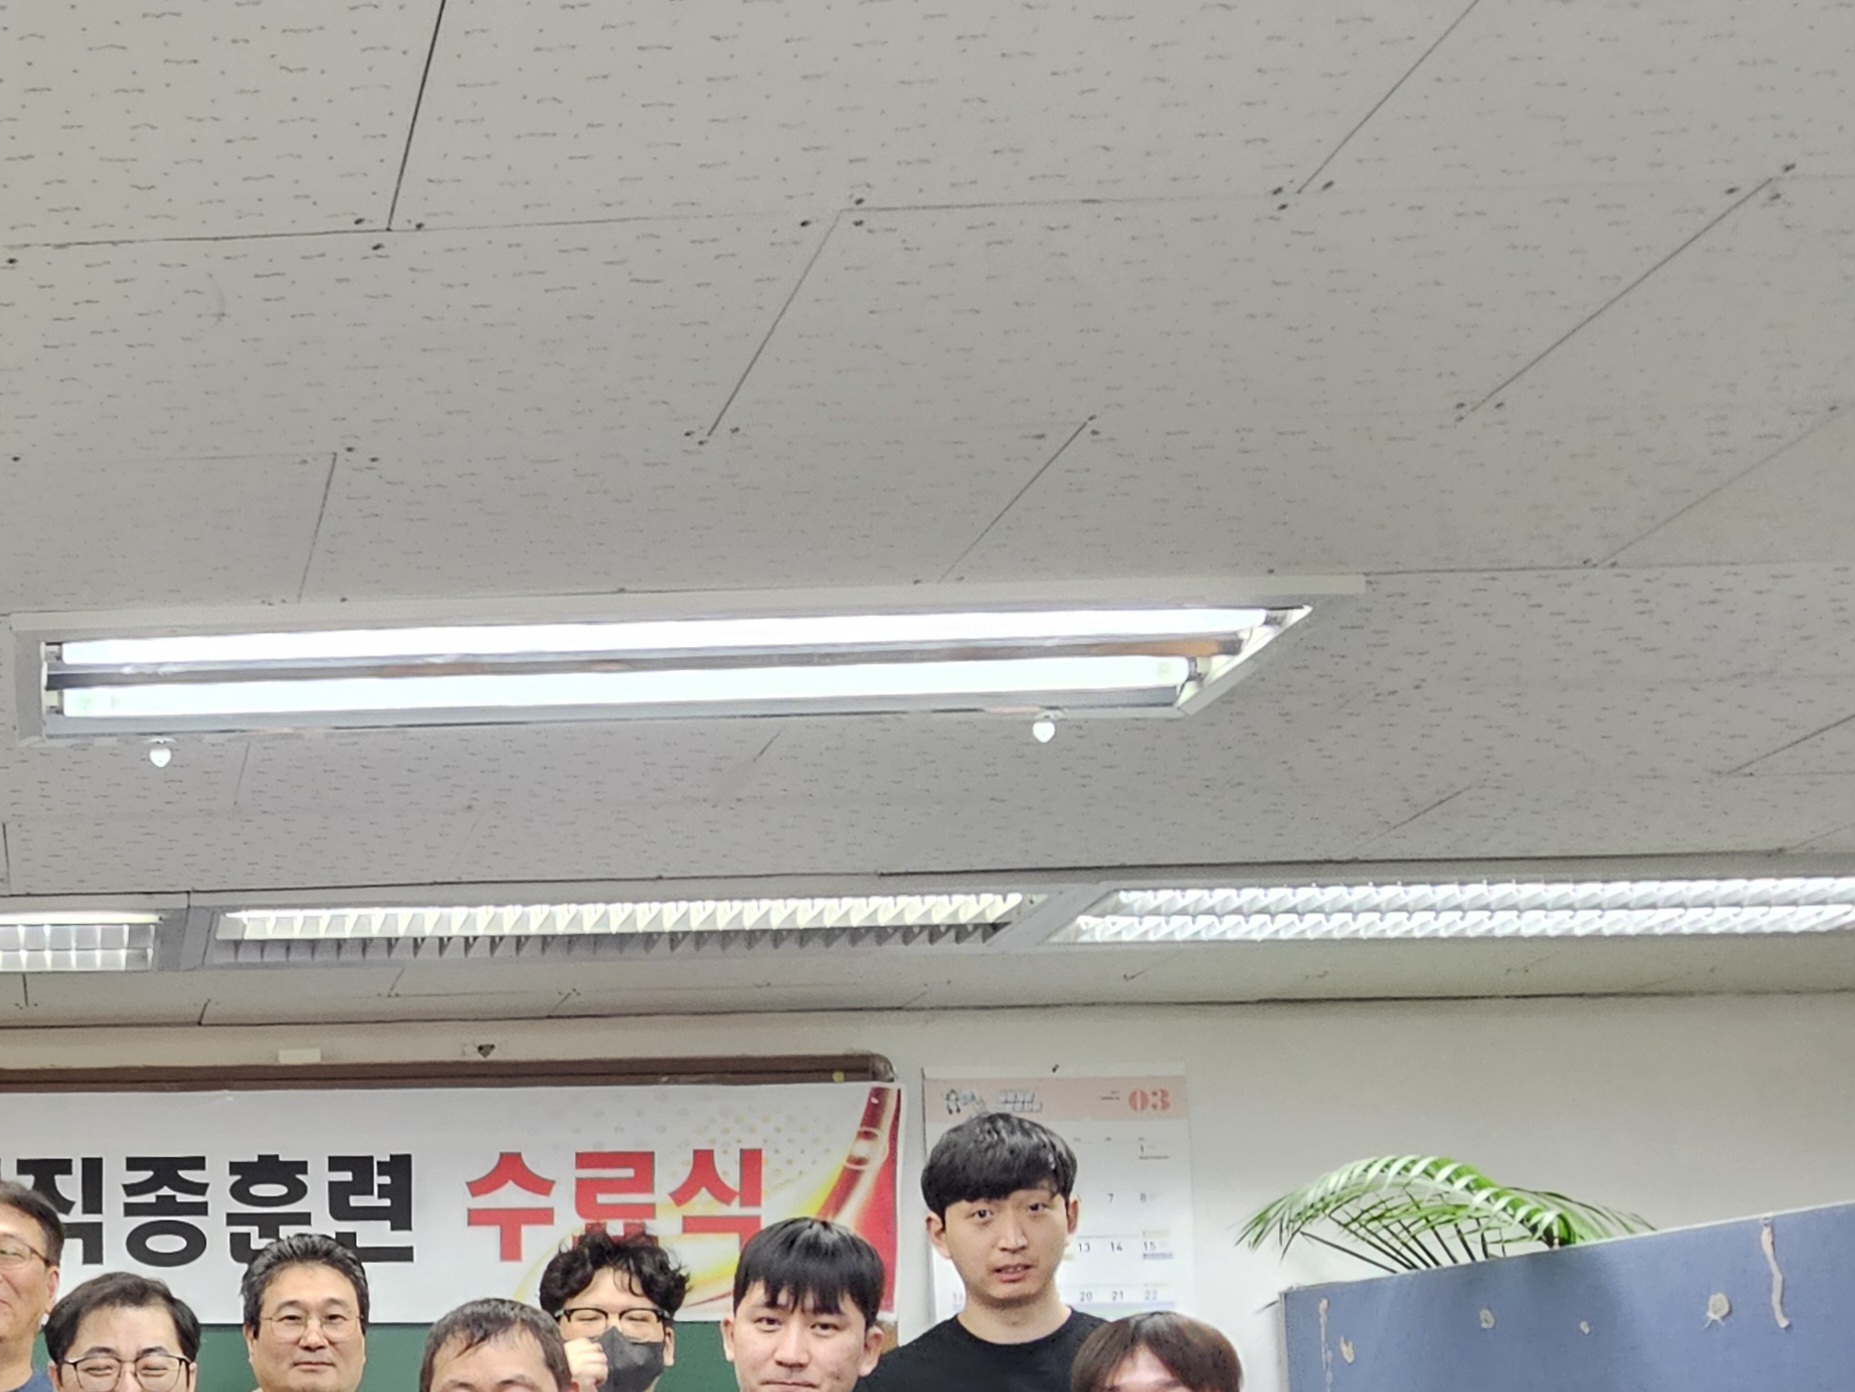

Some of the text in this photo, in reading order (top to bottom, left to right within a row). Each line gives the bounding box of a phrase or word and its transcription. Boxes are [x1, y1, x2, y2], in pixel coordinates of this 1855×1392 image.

[1128, 1088, 1171, 1112] 03
[1078, 1242, 1091, 1253] 13
[1110, 1241, 1123, 1252] 14
[1080, 1291, 1093, 1302] 20
[1112, 1290, 1124, 1301] 21
